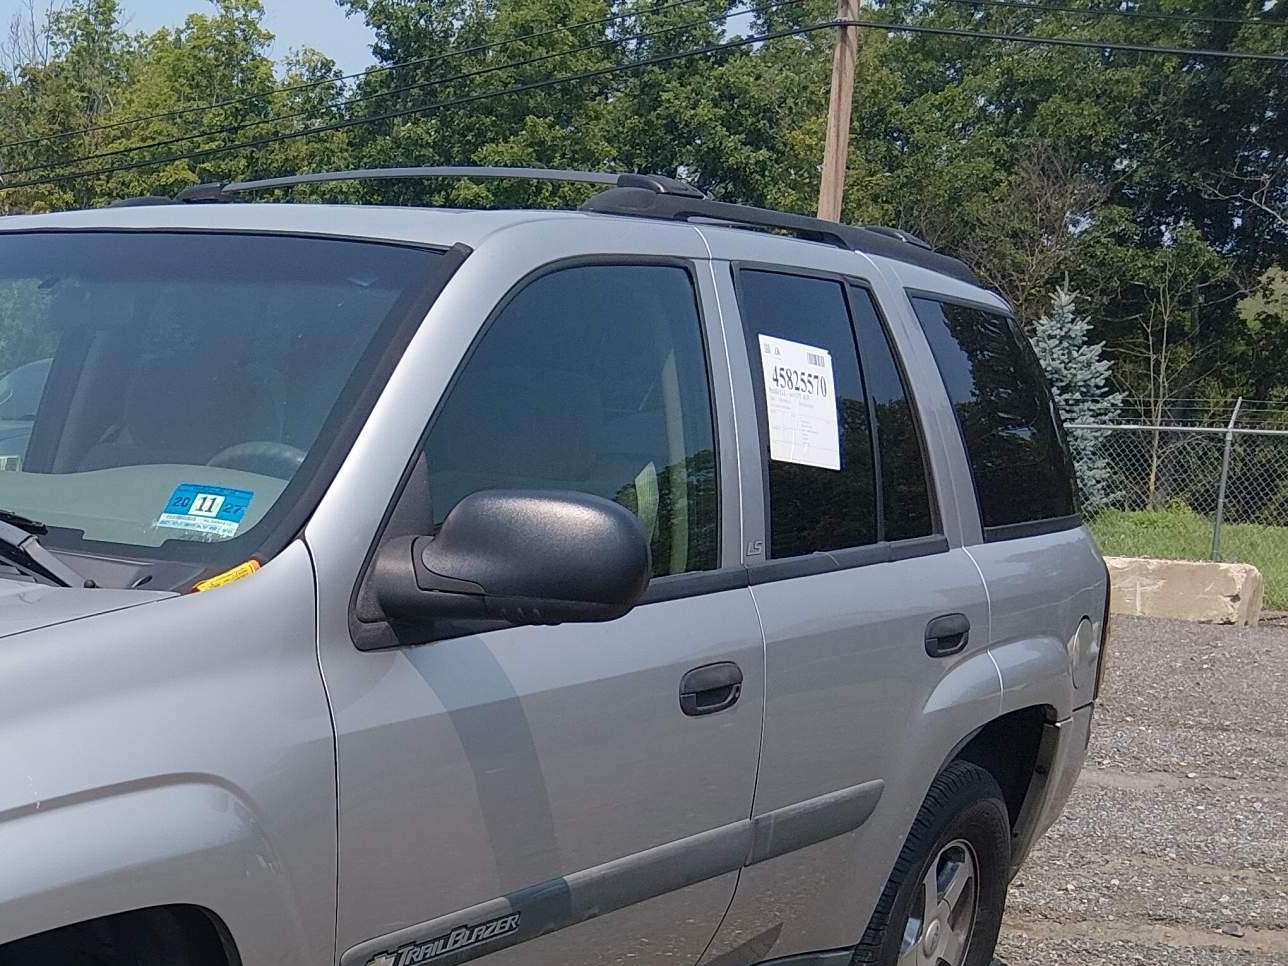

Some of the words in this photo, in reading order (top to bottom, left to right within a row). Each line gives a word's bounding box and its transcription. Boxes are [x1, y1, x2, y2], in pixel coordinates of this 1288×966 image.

[771, 364, 828, 398] 45825570
[172, 496, 191, 508] 20
[194, 495, 218, 513] 11
[745, 540, 763, 557] LS
